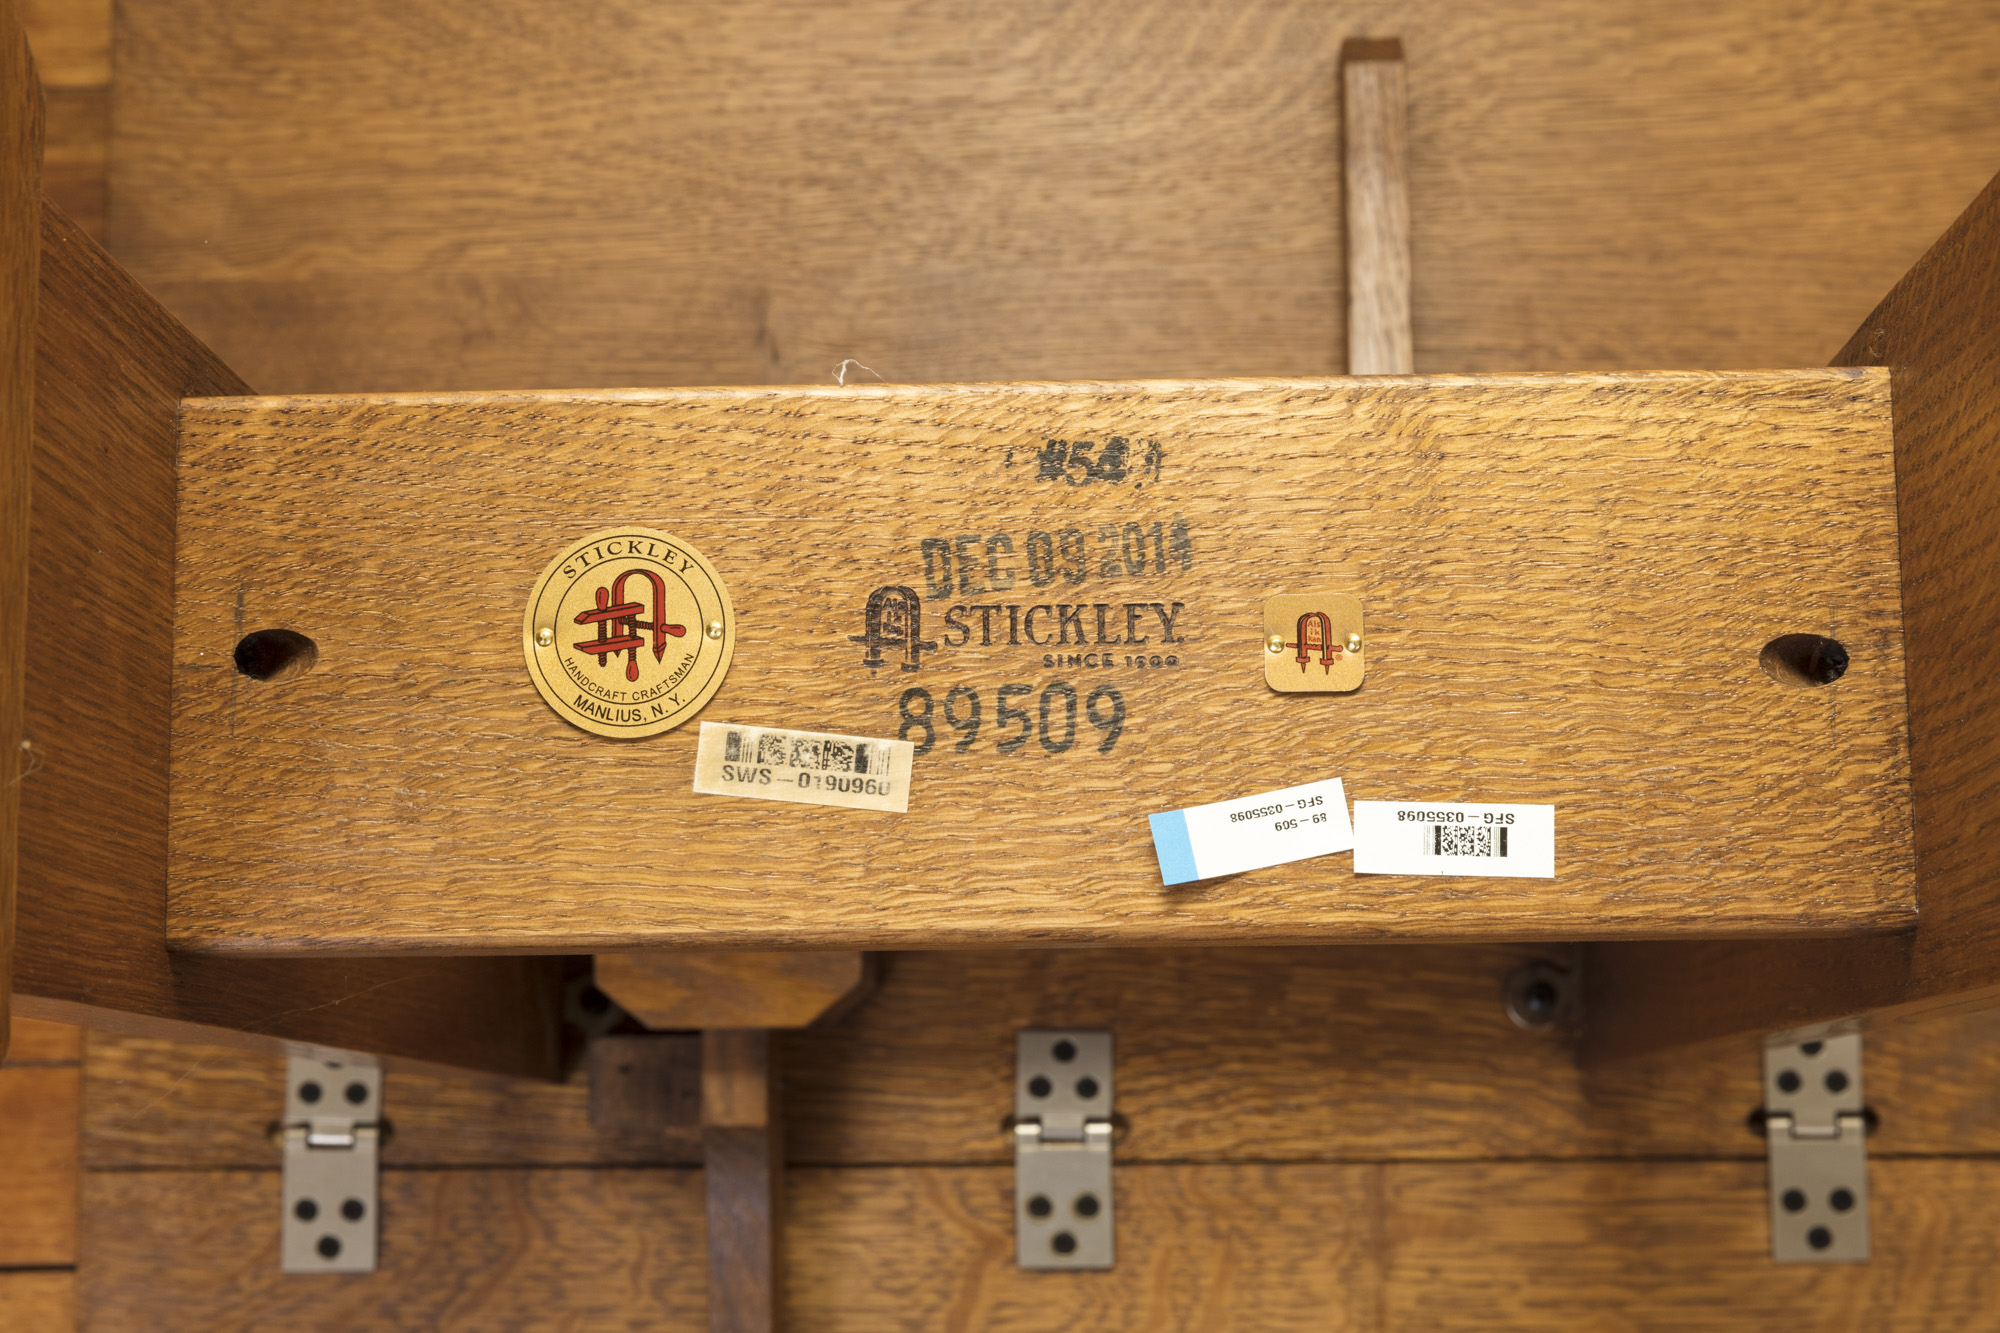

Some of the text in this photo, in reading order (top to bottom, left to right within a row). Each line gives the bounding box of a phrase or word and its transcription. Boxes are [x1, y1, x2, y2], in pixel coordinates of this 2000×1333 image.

[563, 540, 695, 580] STICKLEY
[921, 533, 1016, 601] DEC
[1026, 528, 1087, 588] 09
[564, 653, 694, 702] HANDCRAFT CRAFTSMAN
[1043, 653, 1115, 669] SINCE
[573, 694, 647, 723] MANLIUS,
[899, 681, 1127, 756] 89509
